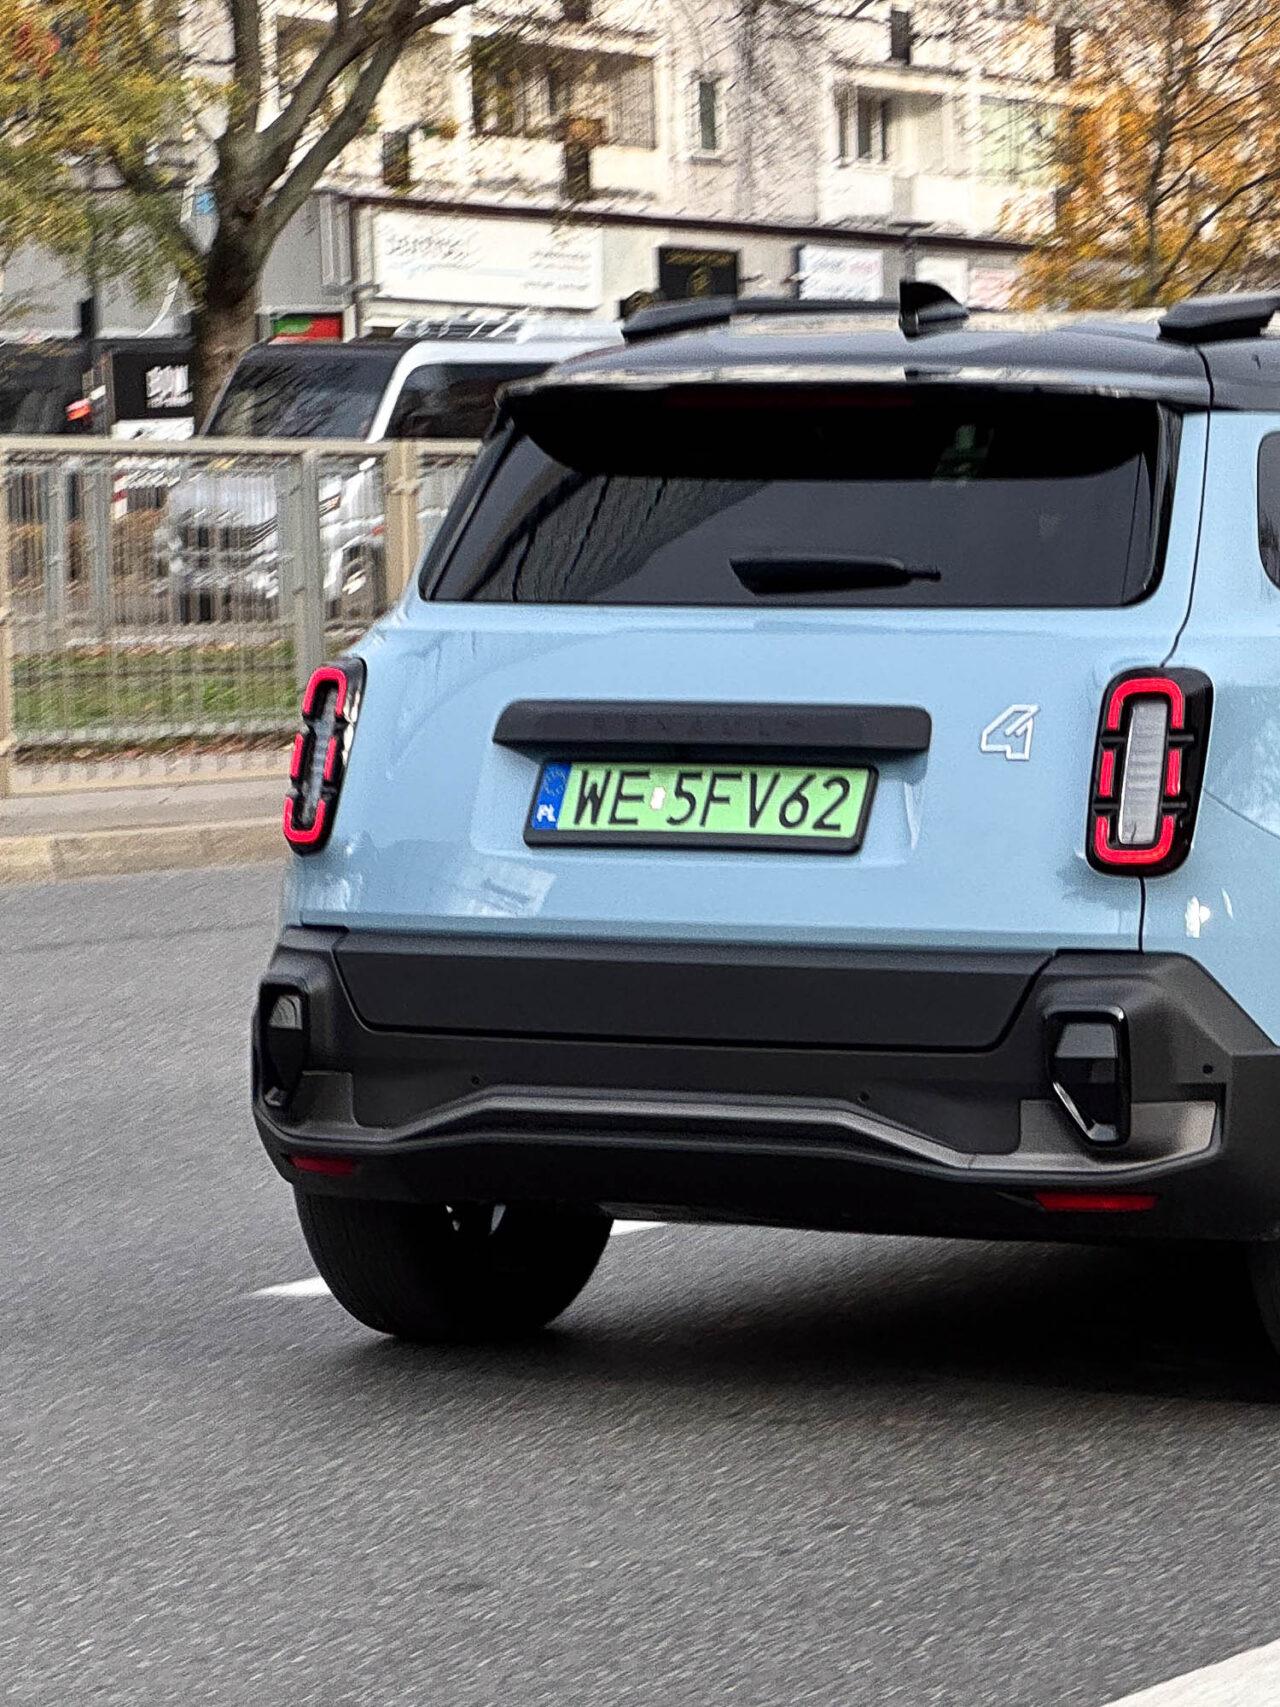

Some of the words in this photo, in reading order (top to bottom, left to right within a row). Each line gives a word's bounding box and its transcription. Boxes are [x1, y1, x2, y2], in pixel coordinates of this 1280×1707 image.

[536, 804, 557, 822] PL
[573, 769, 651, 826] WE
[665, 771, 851, 832] 5FV62
